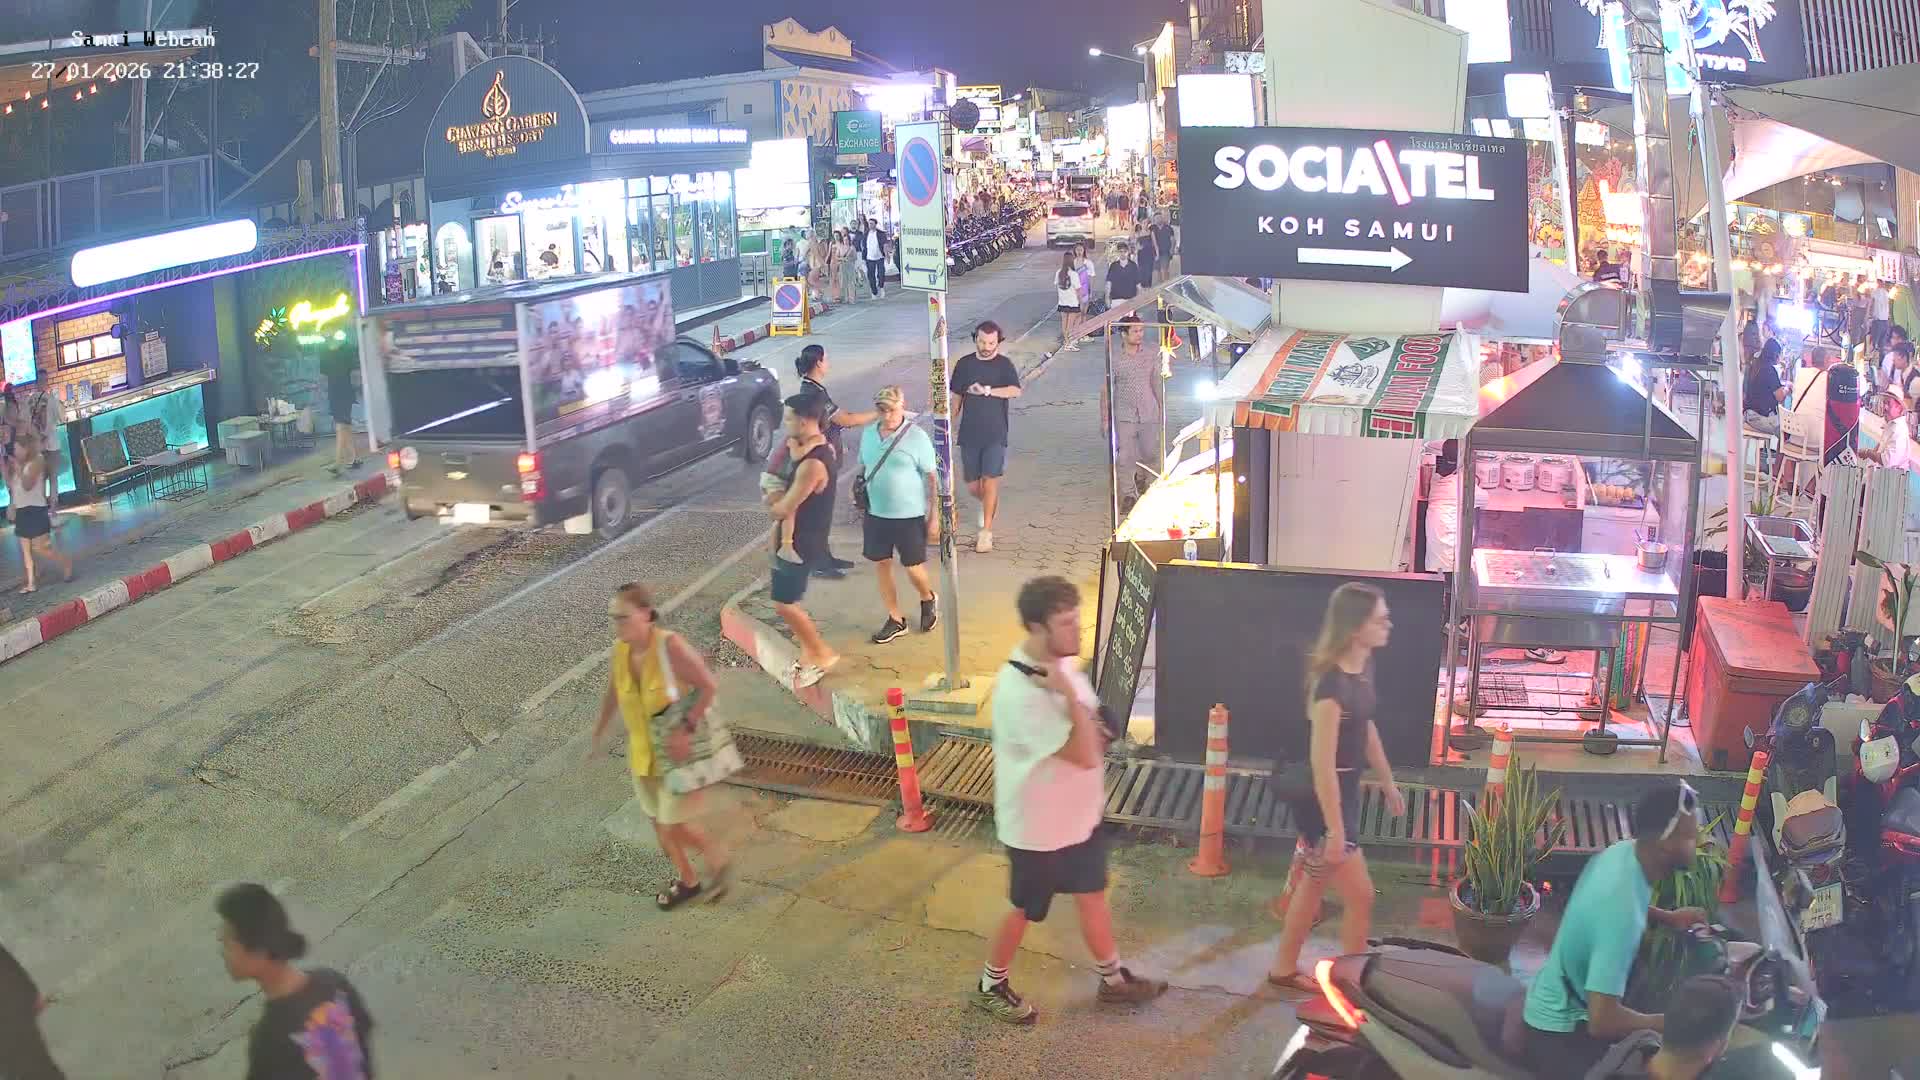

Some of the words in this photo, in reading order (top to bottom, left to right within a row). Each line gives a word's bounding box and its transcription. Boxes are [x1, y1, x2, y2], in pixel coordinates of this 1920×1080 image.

[839, 138, 880, 149] EXCHANGE
[1257, 215, 1324, 235] KOH
[1344, 218, 1453, 242] SAMUI
[906, 247, 915, 256] NO
[915, 248, 939, 257] PARKING
[1394, 336, 1443, 373] FOOD
[1371, 375, 1432, 434] INDIAN
